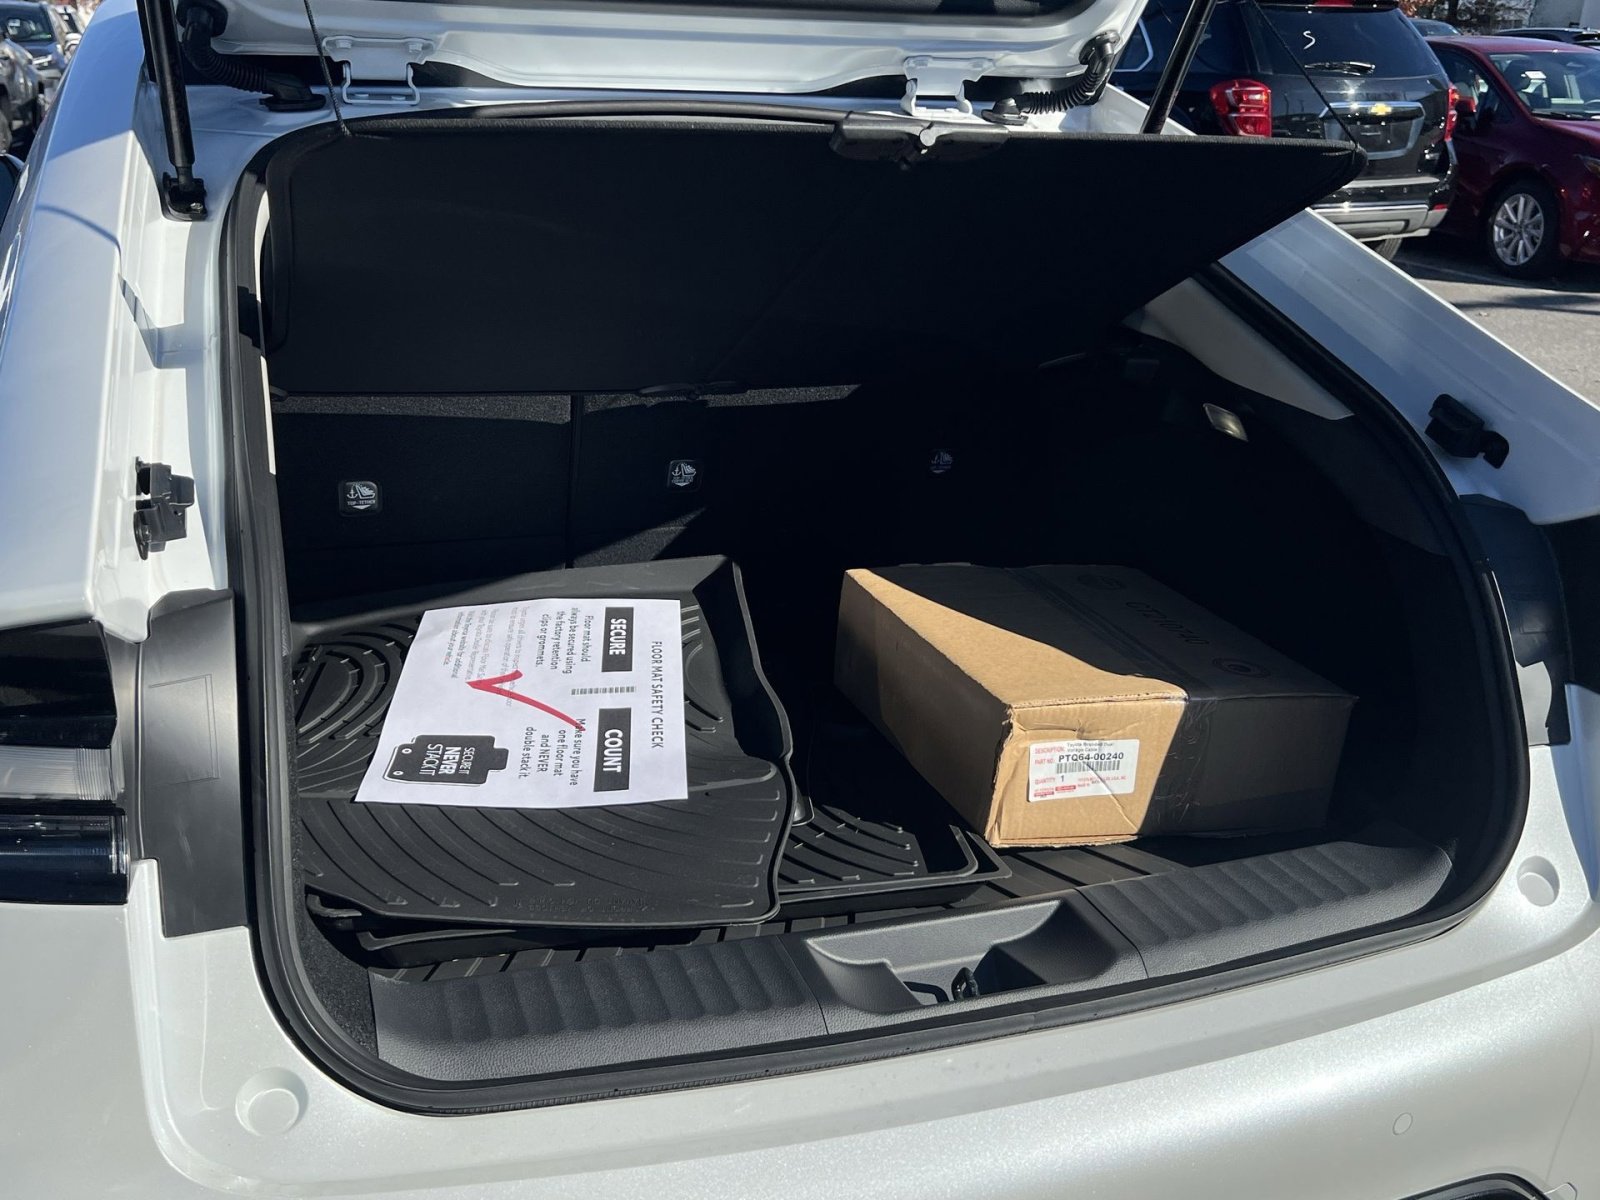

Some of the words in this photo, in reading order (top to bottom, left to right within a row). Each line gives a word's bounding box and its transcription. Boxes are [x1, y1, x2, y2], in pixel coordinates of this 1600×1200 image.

[540, 614, 552, 626] clips
[557, 611, 565, 620] the
[568, 608, 580, 624] always
[584, 616, 594, 629] Floor
[551, 621, 565, 640] factory
[583, 631, 591, 641] mat
[609, 618, 627, 655] SECURE
[566, 633, 576, 655] secured
[581, 642, 592, 662] should
[551, 642, 560, 669] retention
[652, 642, 662, 664] FLOOR
[562, 657, 576, 673] using
[652, 666, 662, 682] MAT
[652, 684, 663, 714] SAFETY
[523, 727, 536, 751] double
[541, 735, 551, 747] and
[558, 730, 566, 743] one
[652, 718, 664, 748] CHECK
[556, 744, 568, 761] floor
[573, 740, 582, 754] sure
[603, 729, 622, 772] COUNT
[421, 744, 443, 768] STACK
[438, 747, 461, 774] NEVER
[460, 747, 475, 769] SECURE
[519, 753, 532, 771] stack
[537, 749, 550, 772] NEVER
[570, 756, 580, 768] you
[1059, 752, 1124, 762] PTQ64-00240
[553, 763, 563, 776] mat
[570, 770, 583, 785] have
